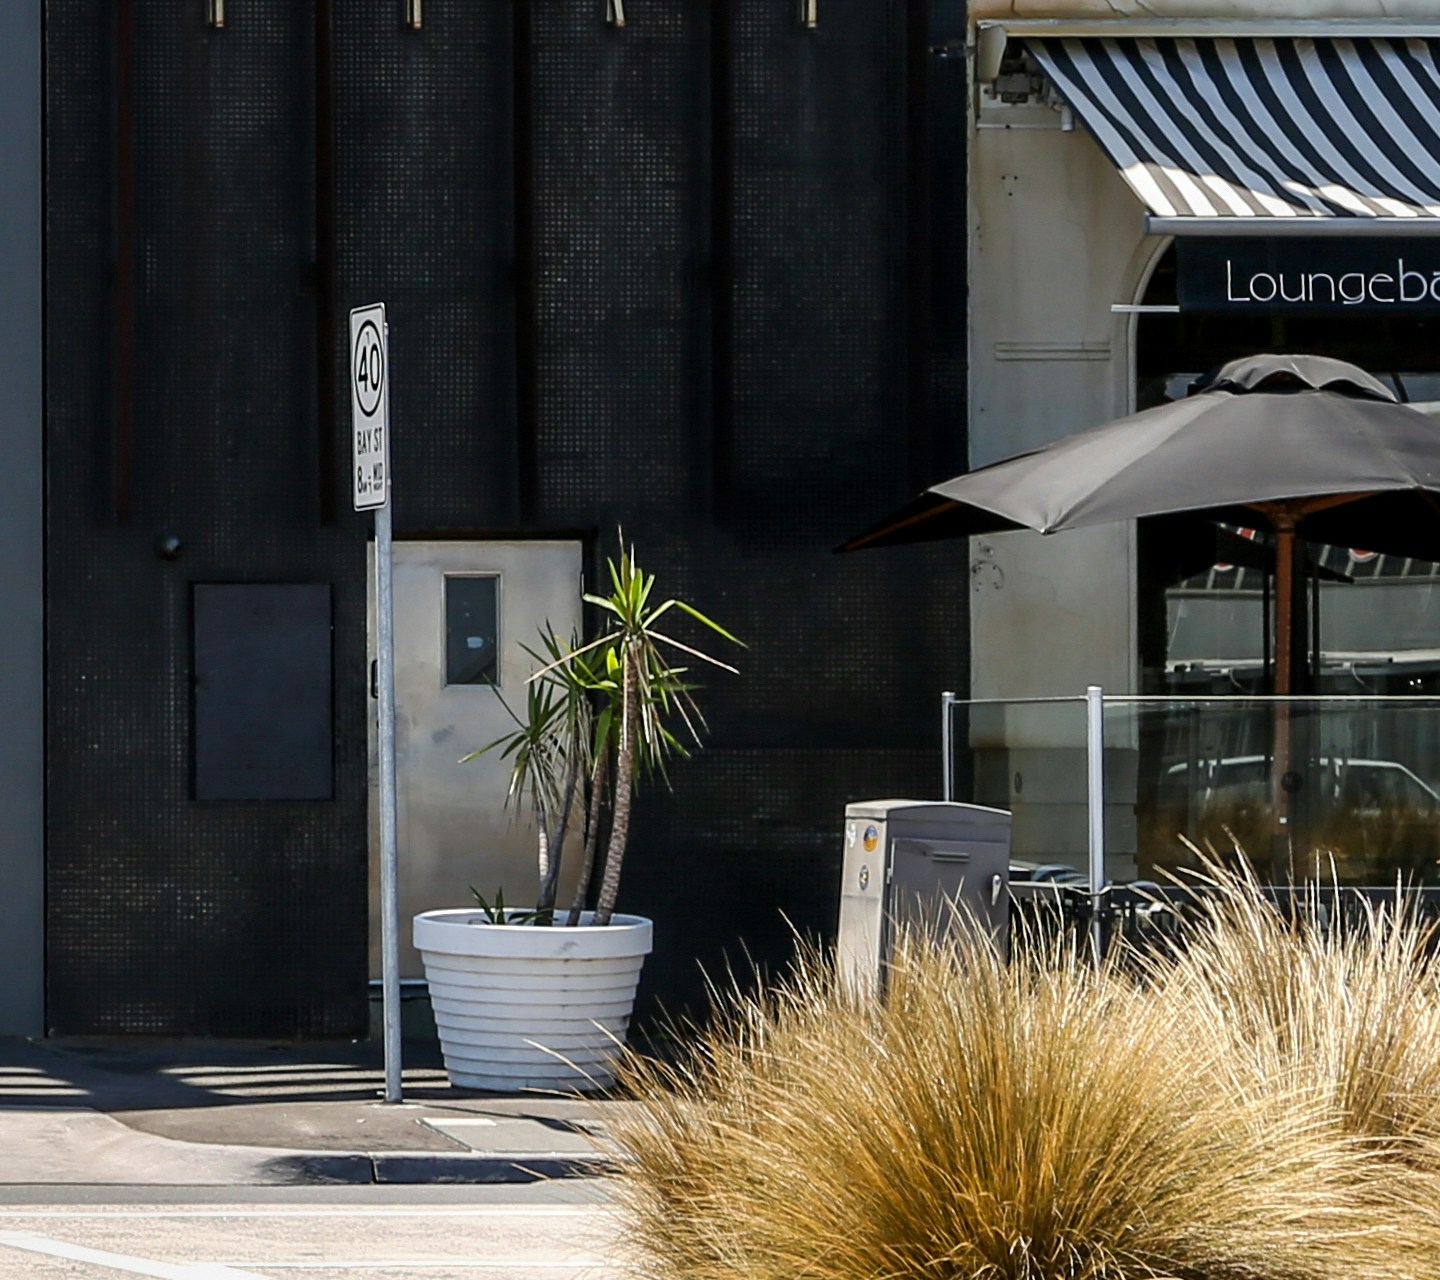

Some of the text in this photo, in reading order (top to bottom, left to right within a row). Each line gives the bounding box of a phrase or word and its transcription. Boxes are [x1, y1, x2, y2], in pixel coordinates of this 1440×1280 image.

[358, 343, 380, 393] 40
[357, 426, 382, 456] BAY ST
